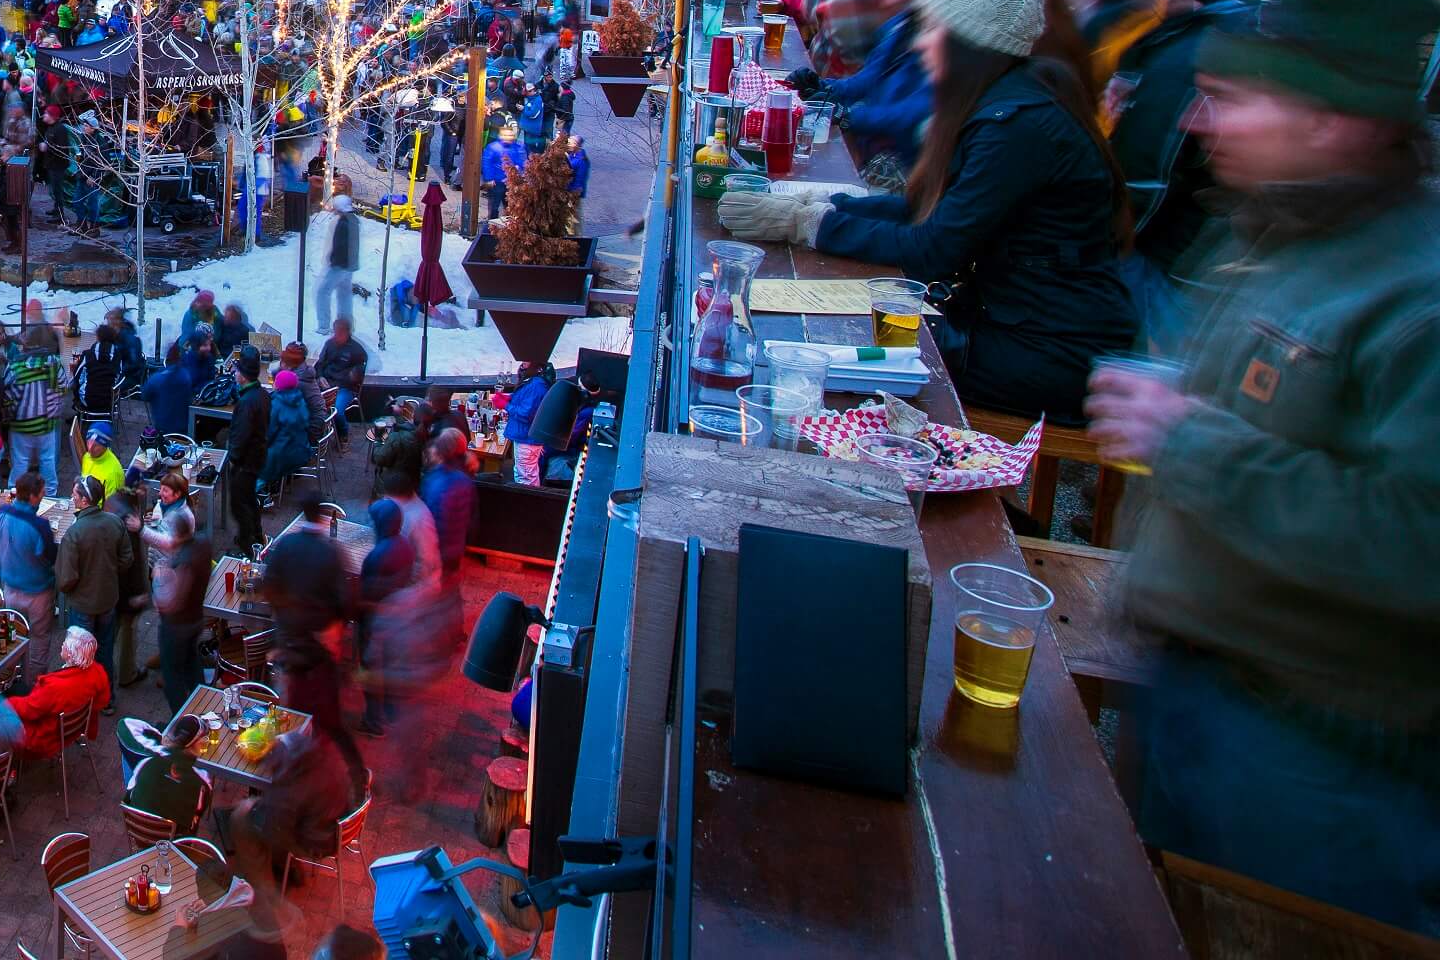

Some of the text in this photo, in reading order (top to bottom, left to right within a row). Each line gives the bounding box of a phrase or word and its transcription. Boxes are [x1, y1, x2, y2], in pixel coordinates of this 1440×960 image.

[50, 55, 106, 84] ASPEN SNOWMASS
[156, 73, 245, 88] ASPEN SNOWMASS
